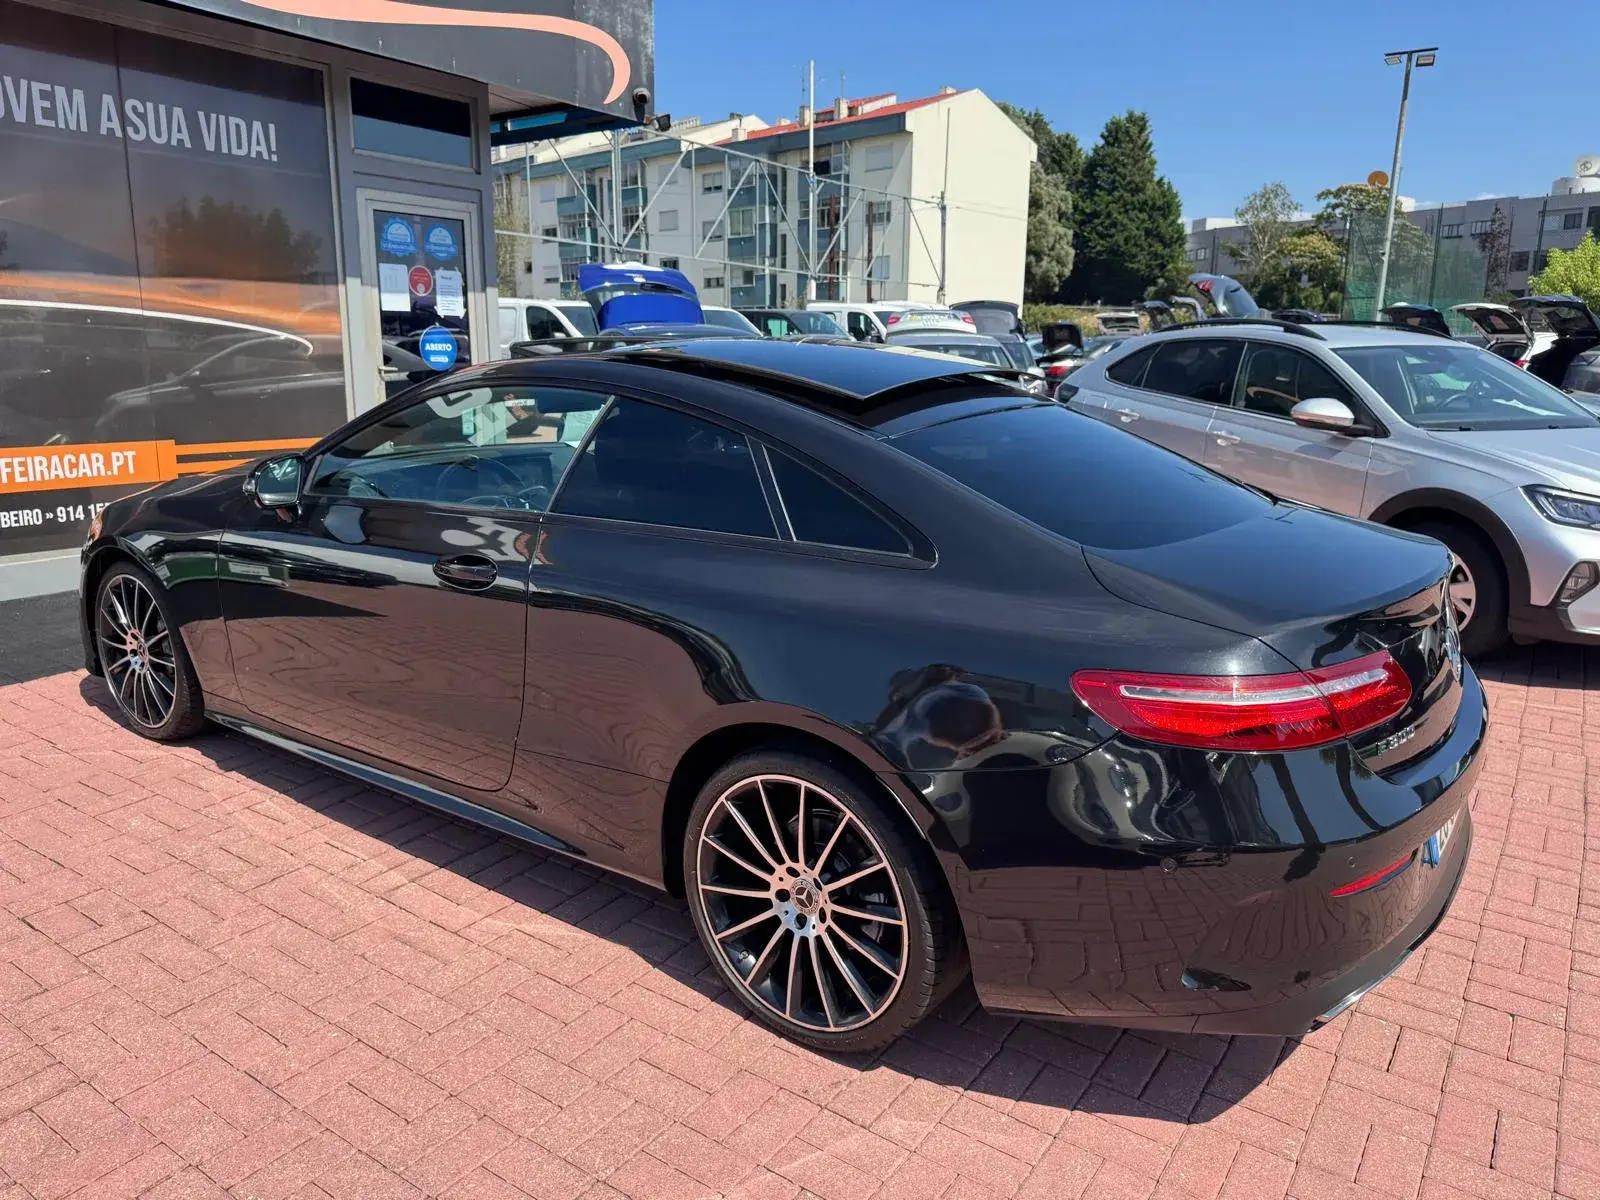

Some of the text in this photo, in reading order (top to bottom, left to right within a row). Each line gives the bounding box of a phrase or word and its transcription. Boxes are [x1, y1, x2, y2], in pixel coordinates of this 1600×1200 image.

[0, 74, 88, 132] VEM
[197, 110, 278, 162] VIDA!
[0, 450, 137, 484] FEIRACAR.PT
[56, 504, 86, 522] 914
